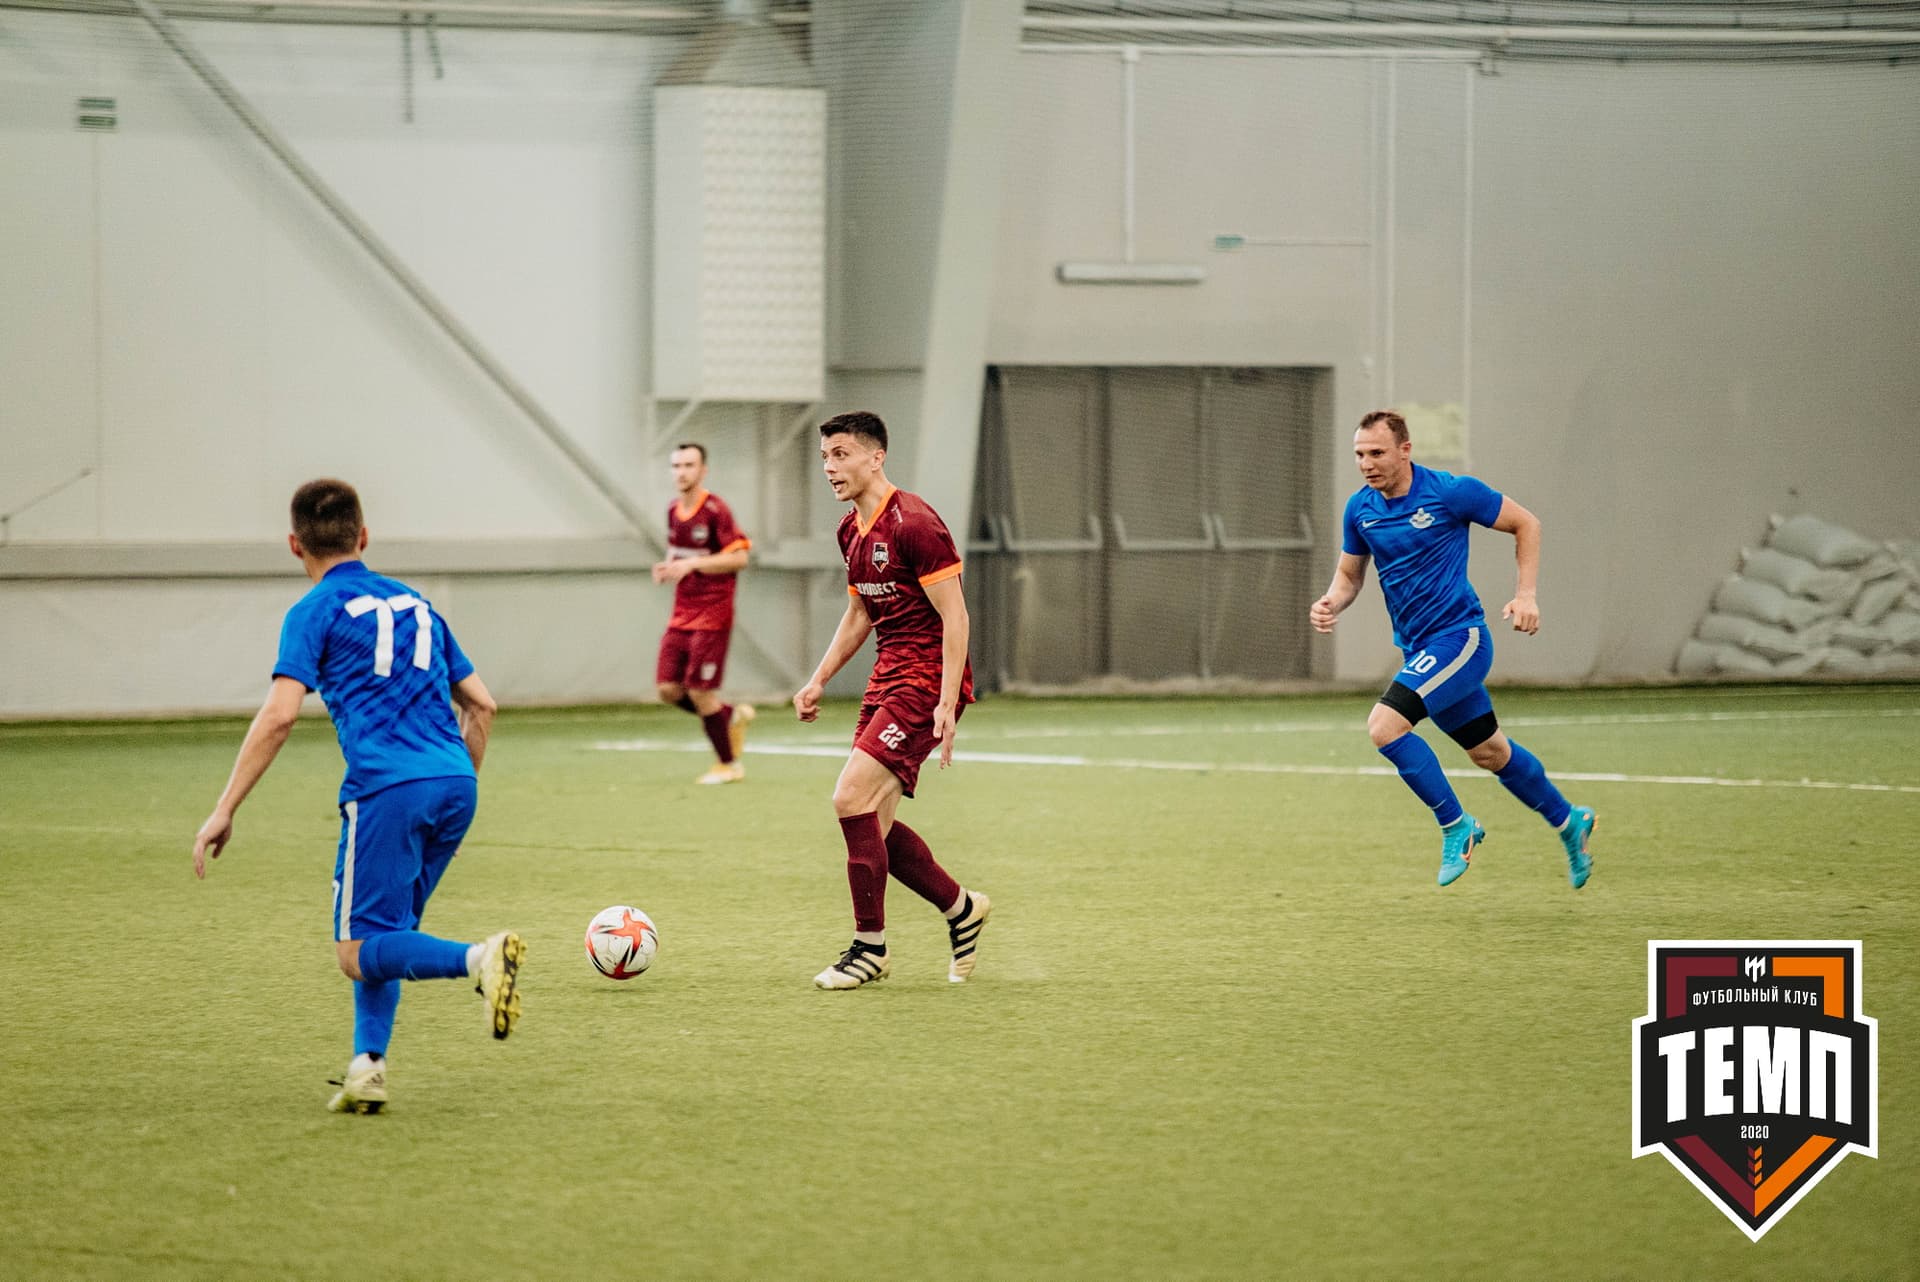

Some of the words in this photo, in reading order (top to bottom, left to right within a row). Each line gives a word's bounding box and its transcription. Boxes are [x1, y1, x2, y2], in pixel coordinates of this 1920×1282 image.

[344, 594, 433, 677] 77
[1408, 650, 1437, 674] 10
[878, 723, 907, 750] 22
